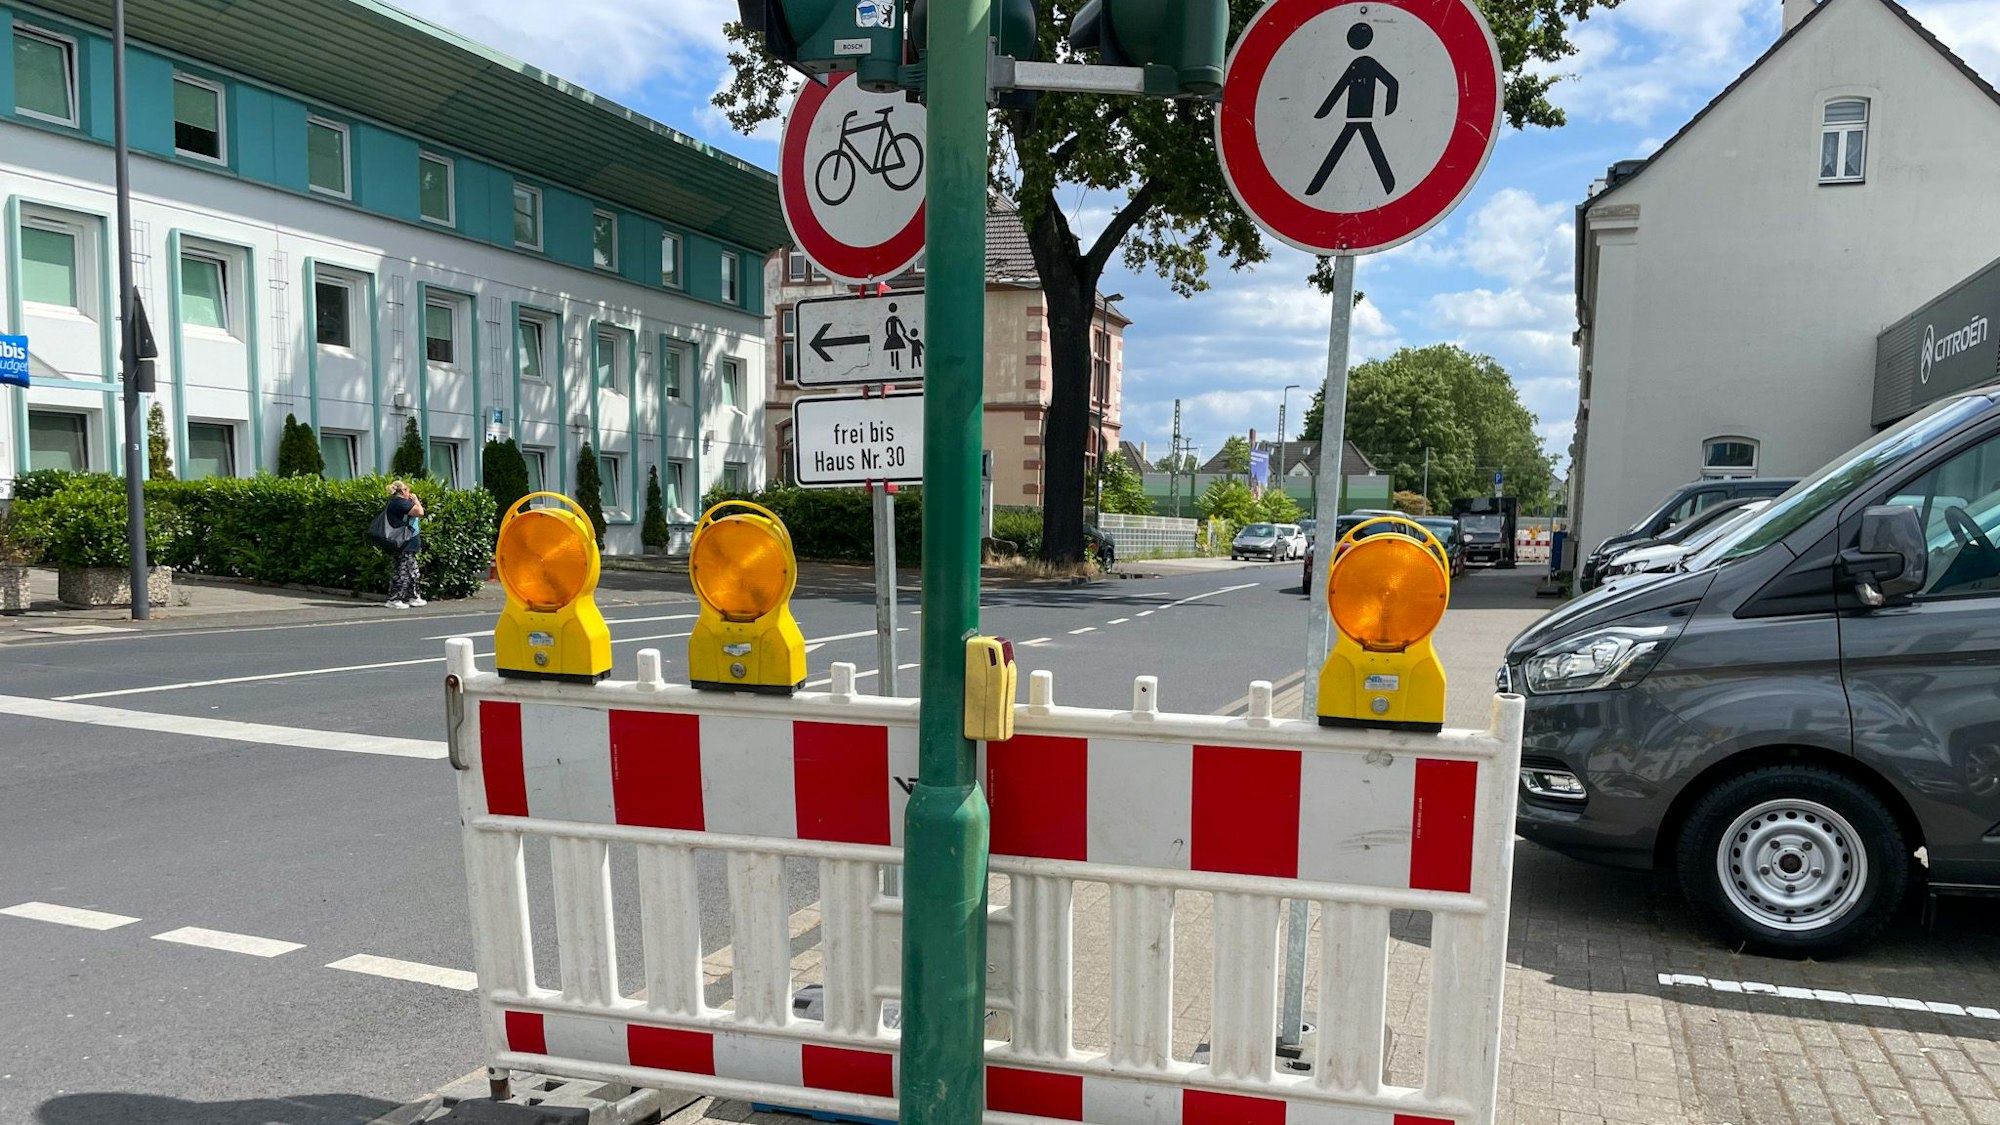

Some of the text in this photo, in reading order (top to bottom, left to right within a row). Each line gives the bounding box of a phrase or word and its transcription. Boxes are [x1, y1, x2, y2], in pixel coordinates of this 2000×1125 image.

[0, 359, 28, 374] udget
[833, 420, 894, 445] frei bis
[815, 446, 905, 472] Haus Nr. 30
